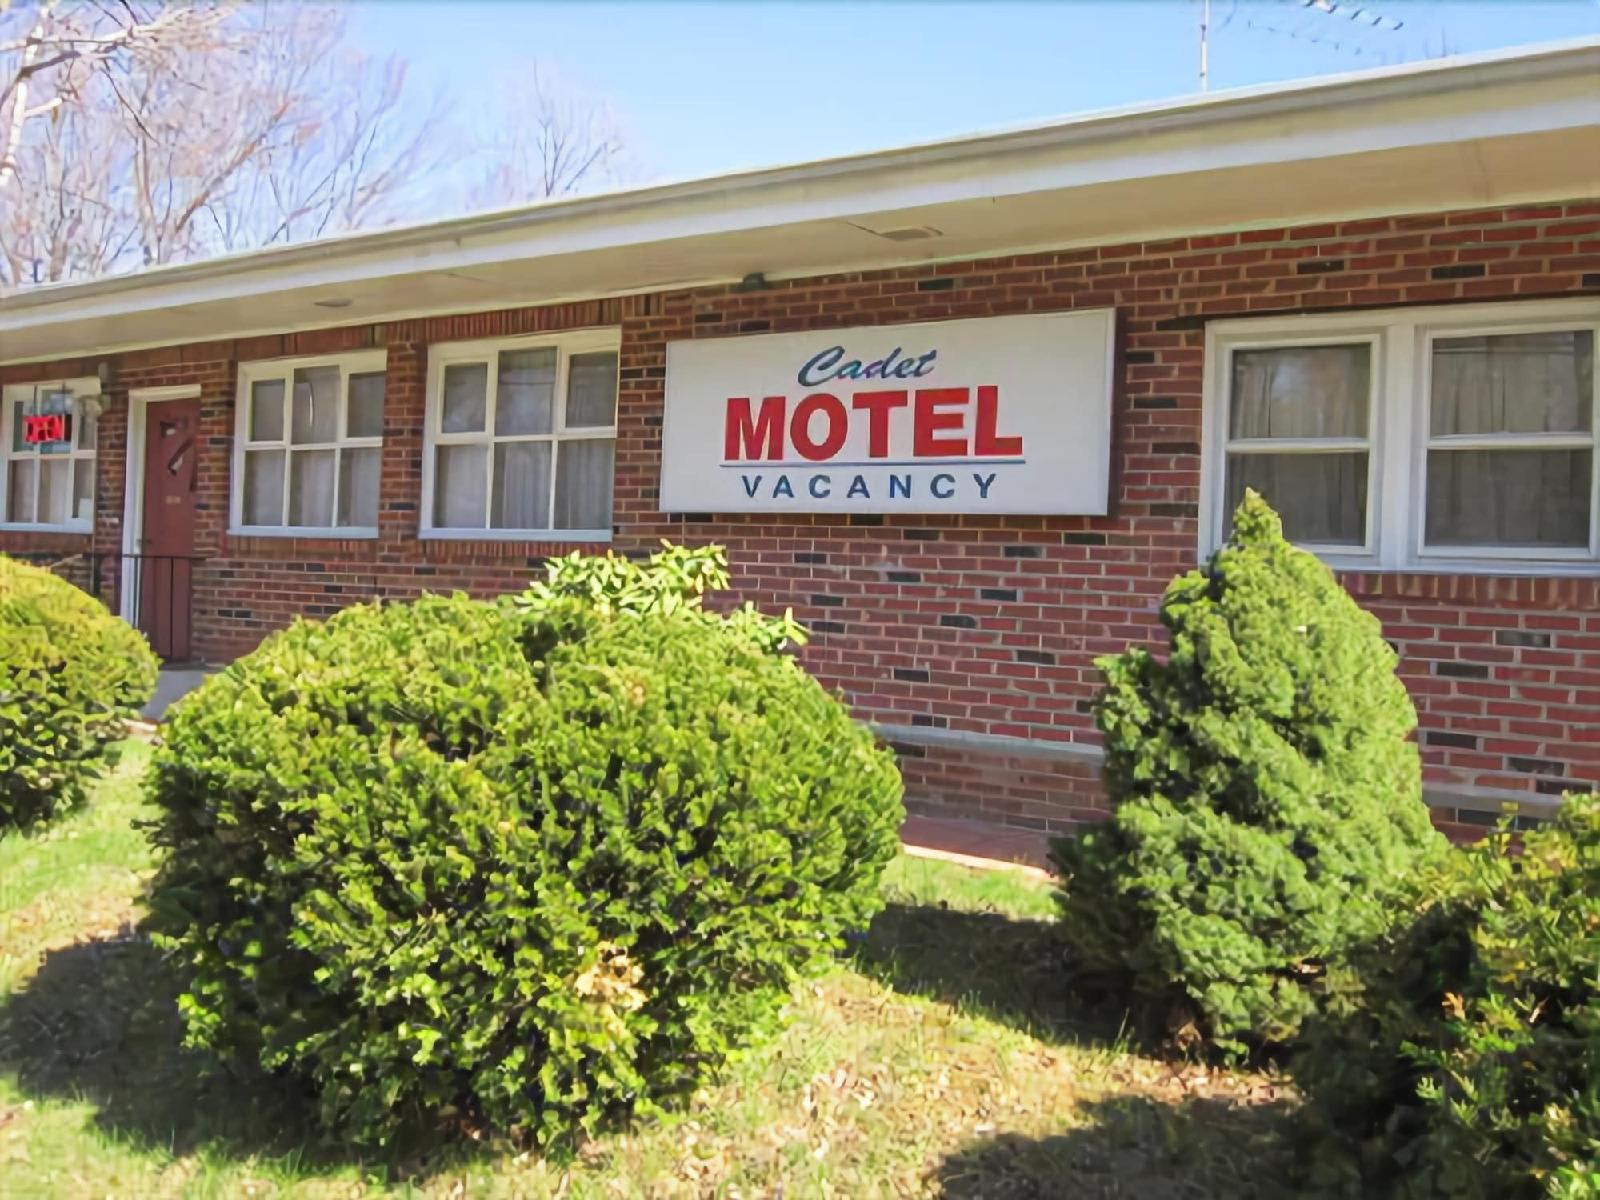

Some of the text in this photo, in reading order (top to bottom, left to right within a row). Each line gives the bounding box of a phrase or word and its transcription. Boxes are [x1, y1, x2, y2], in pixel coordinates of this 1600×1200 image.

[798, 345, 936, 386] Cadet
[724, 385, 1022, 461] MOTEL
[741, 473, 996, 498] VACANCY
